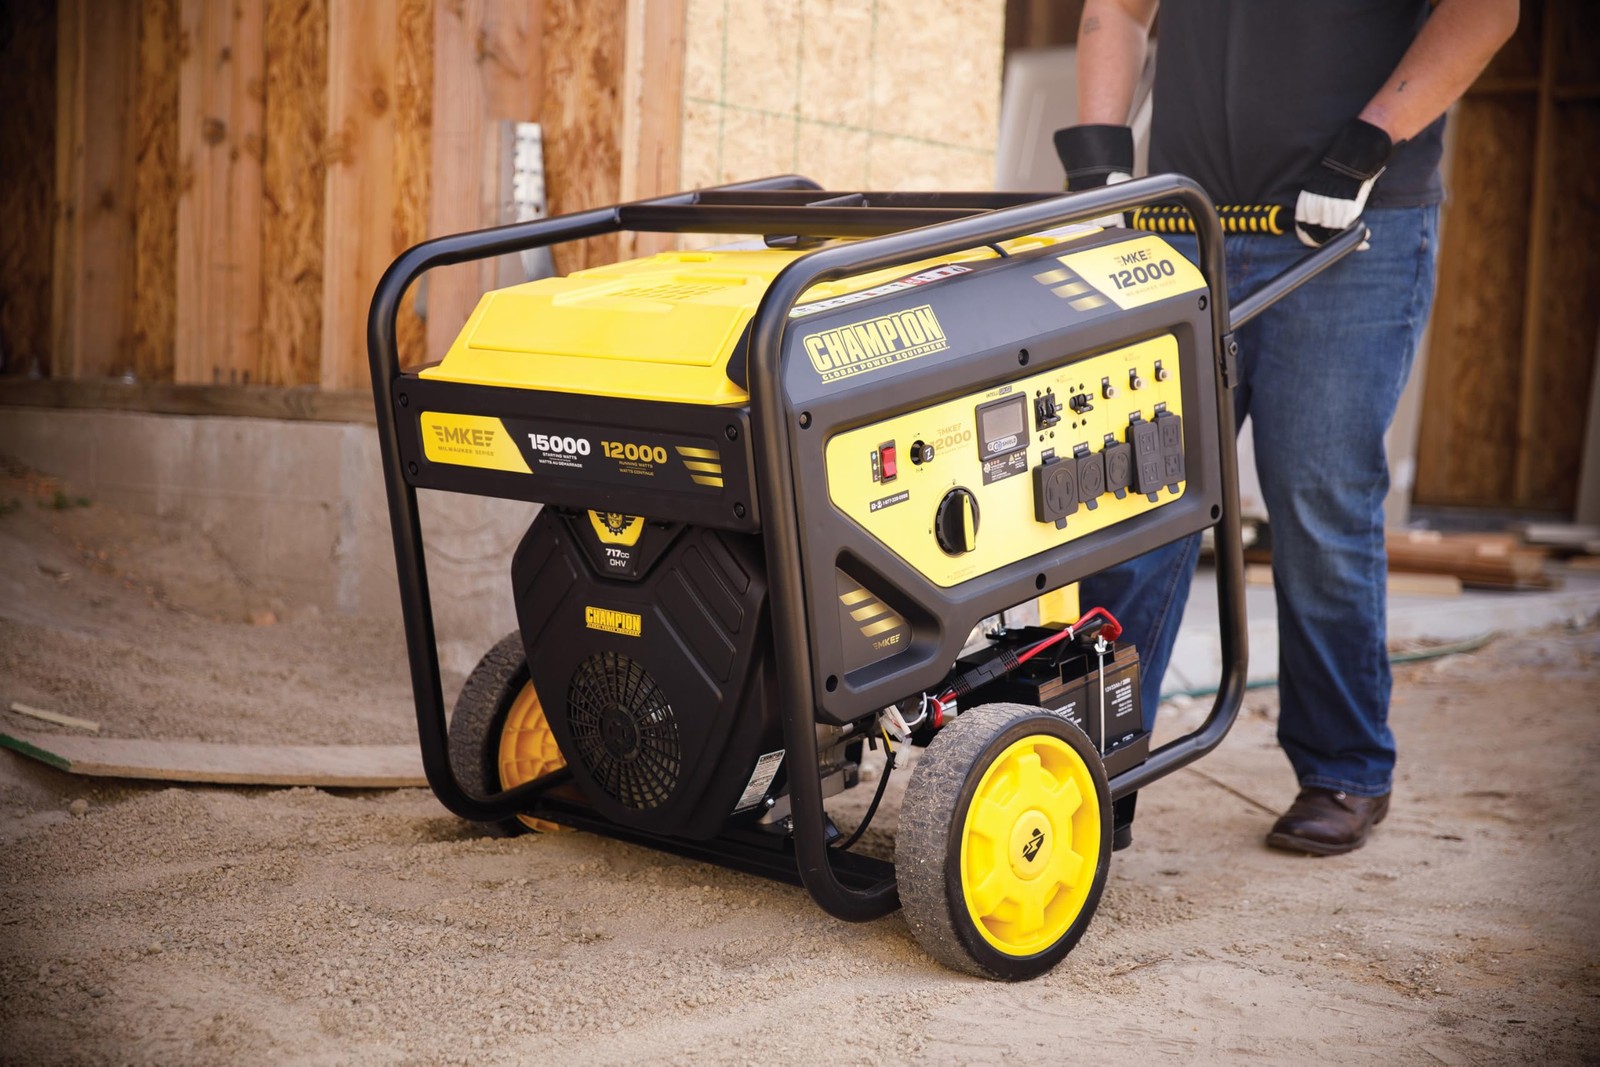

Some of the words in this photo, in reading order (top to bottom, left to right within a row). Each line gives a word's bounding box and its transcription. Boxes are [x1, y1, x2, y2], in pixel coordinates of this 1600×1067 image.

[1121, 250, 1148, 265] MKE
[1109, 259, 1175, 290] 12000
[804, 305, 945, 373] CHAMPION
[822, 364, 859, 381] GLOBAL
[861, 354, 893, 370] POWER
[895, 342, 948, 361] EQUIPMENT
[444, 426, 485, 447] MKE
[528, 433, 591, 456] 15000
[601, 441, 668, 464] 12000
[609, 559, 626, 567] OHV
[586, 607, 641, 632] CHAMPION
[878, 635, 896, 649] MKE
